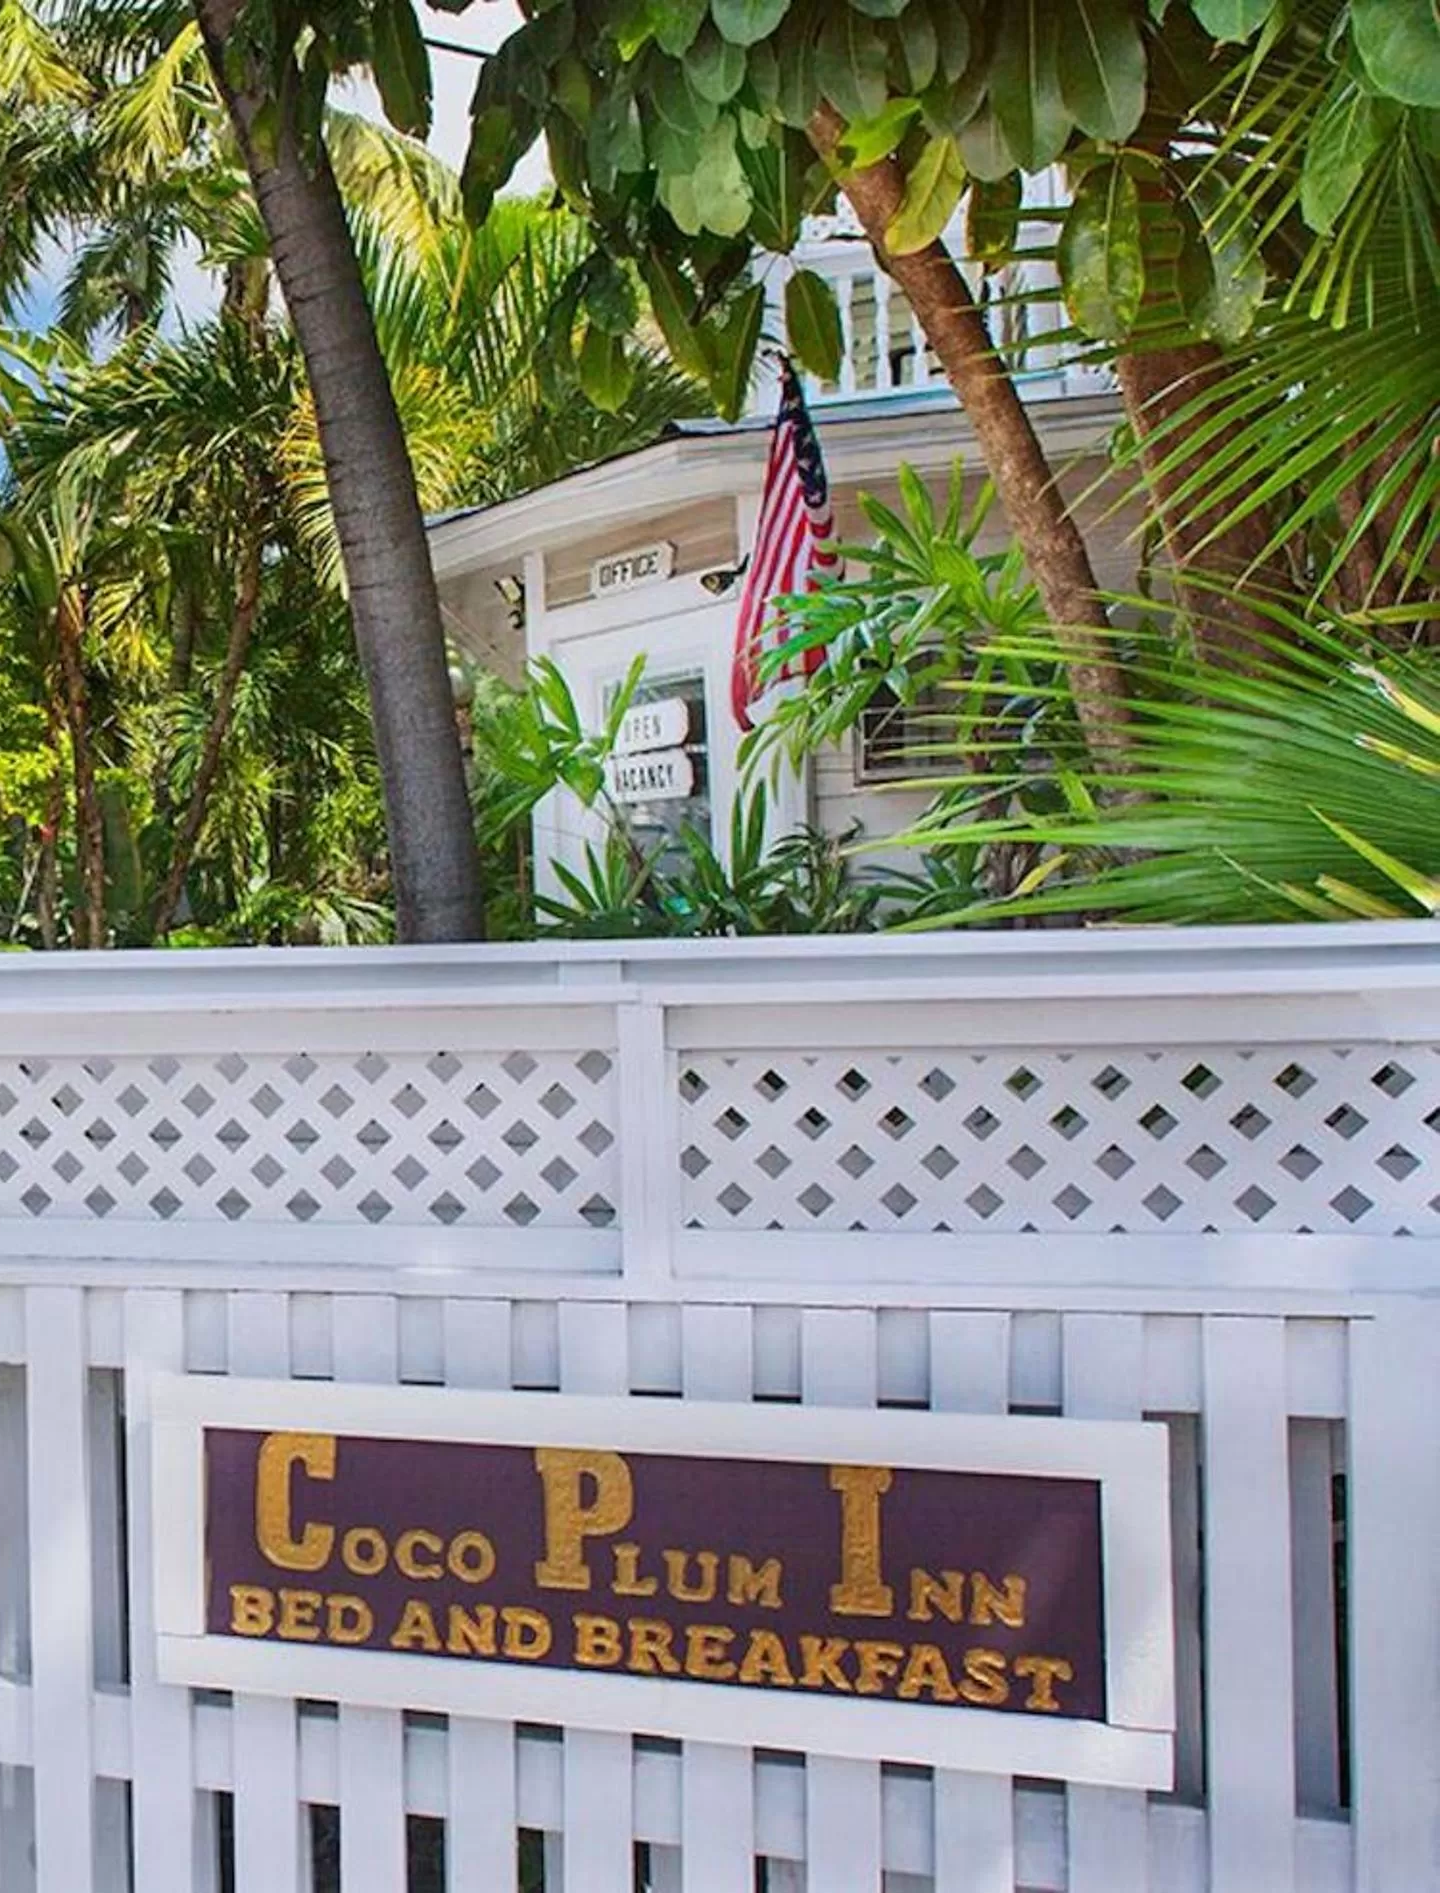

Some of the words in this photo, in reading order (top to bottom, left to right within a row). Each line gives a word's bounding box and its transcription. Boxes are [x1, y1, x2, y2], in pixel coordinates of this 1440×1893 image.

[600, 550, 658, 588] OFFICE
[255, 1431, 496, 1583] COCO
[534, 1447, 784, 1606] PLUM
[829, 1464, 1027, 1628] INN
[229, 1584, 374, 1643] BED
[390, 1600, 553, 1660] AND
[572, 1612, 1074, 1711] BREAKFAST
